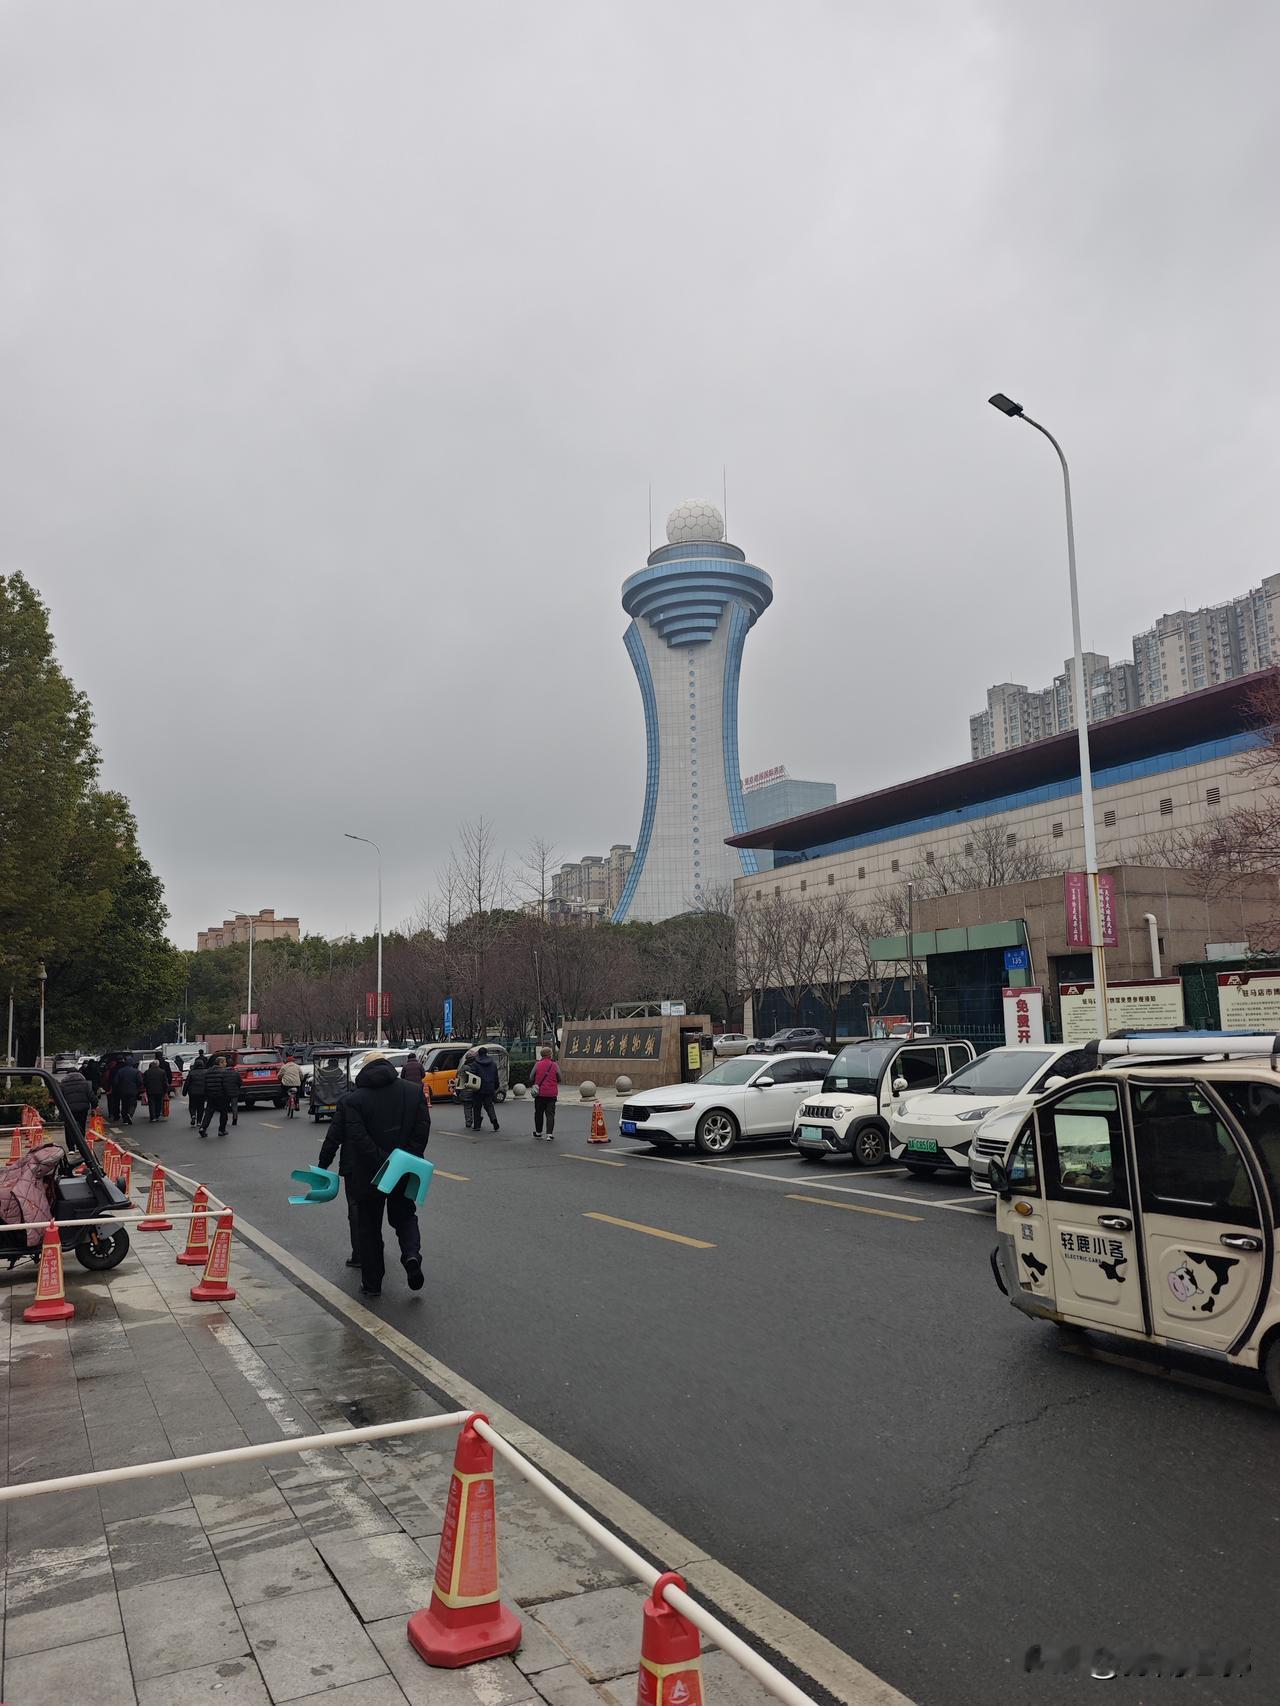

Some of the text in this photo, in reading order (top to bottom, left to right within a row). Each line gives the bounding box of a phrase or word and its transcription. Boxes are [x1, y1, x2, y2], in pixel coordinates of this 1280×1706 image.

[569, 1033, 656, 1057] 驻马店市博物馆
[1061, 1232, 1124, 1259] 轻鹿小客
[1065, 1253, 1087, 1262] ELECTRIC
